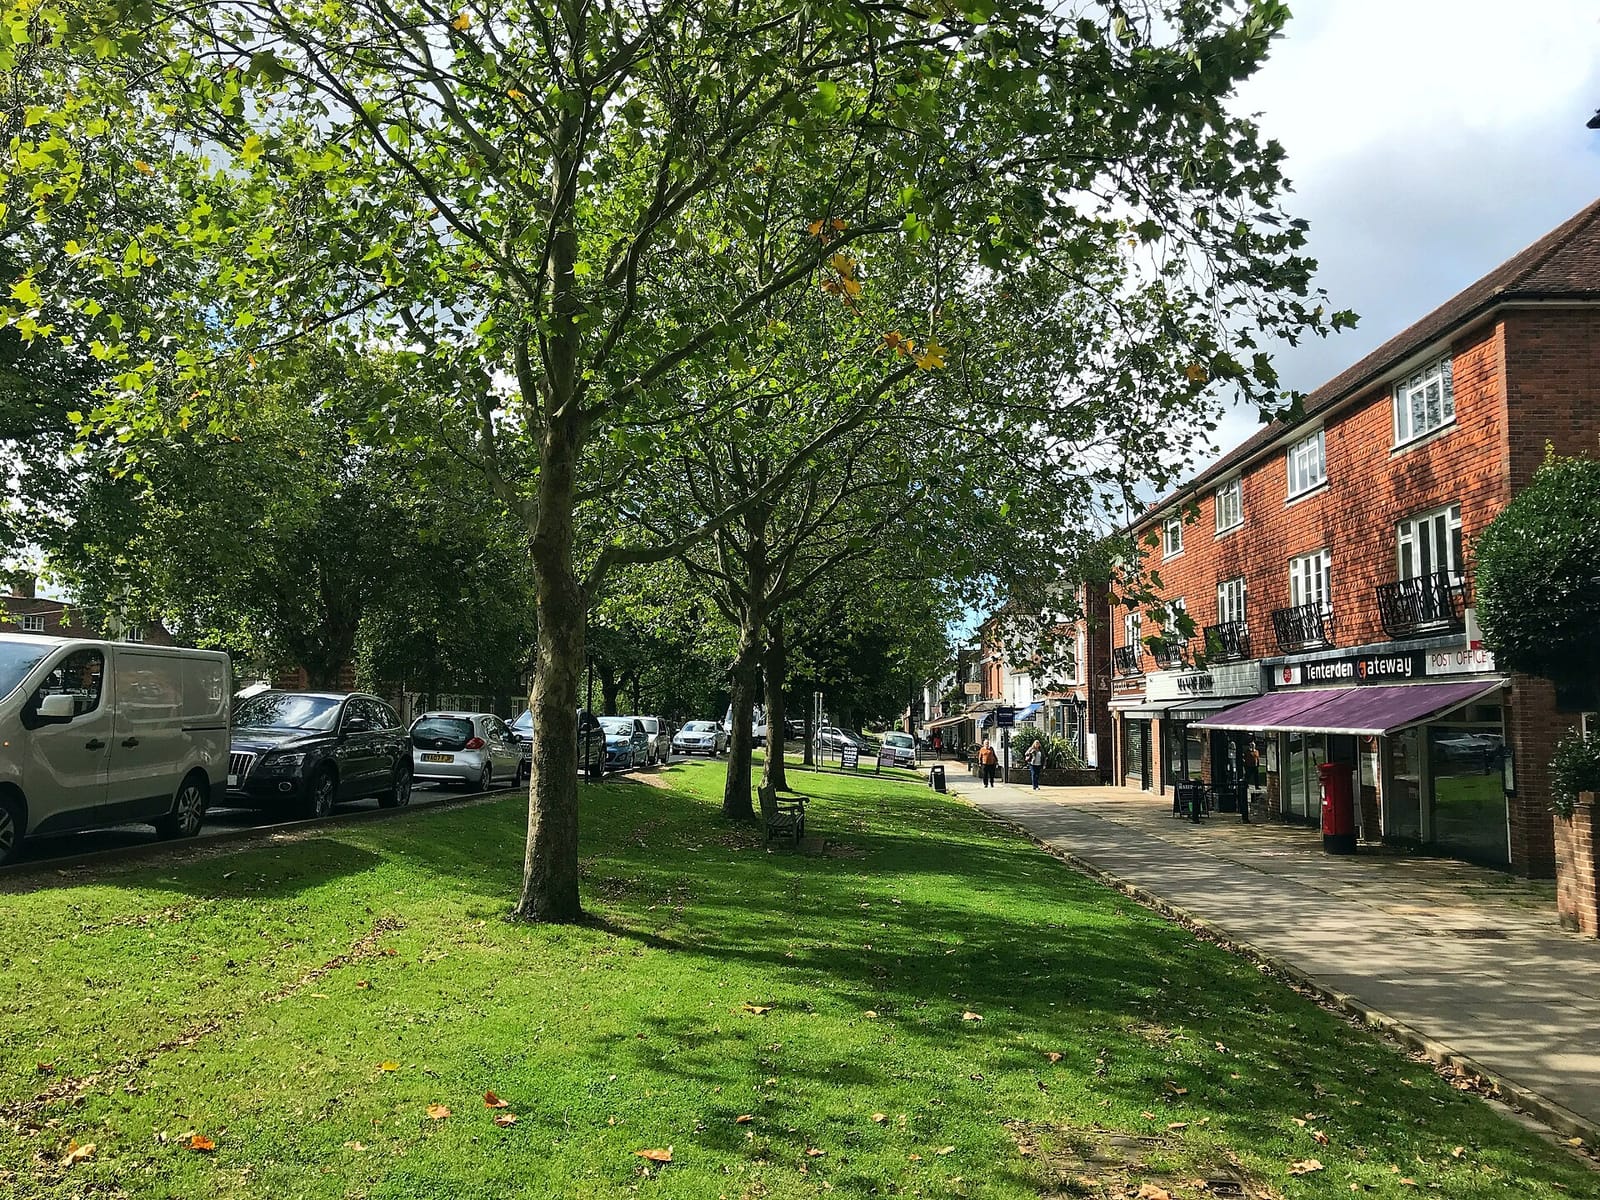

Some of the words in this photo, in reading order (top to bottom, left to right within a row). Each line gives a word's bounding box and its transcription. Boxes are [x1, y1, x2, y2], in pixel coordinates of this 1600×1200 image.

[1431, 652, 1452, 667] POST
[1456, 649, 1487, 666] OFFICE
[1305, 660, 1353, 680] Tenterden
